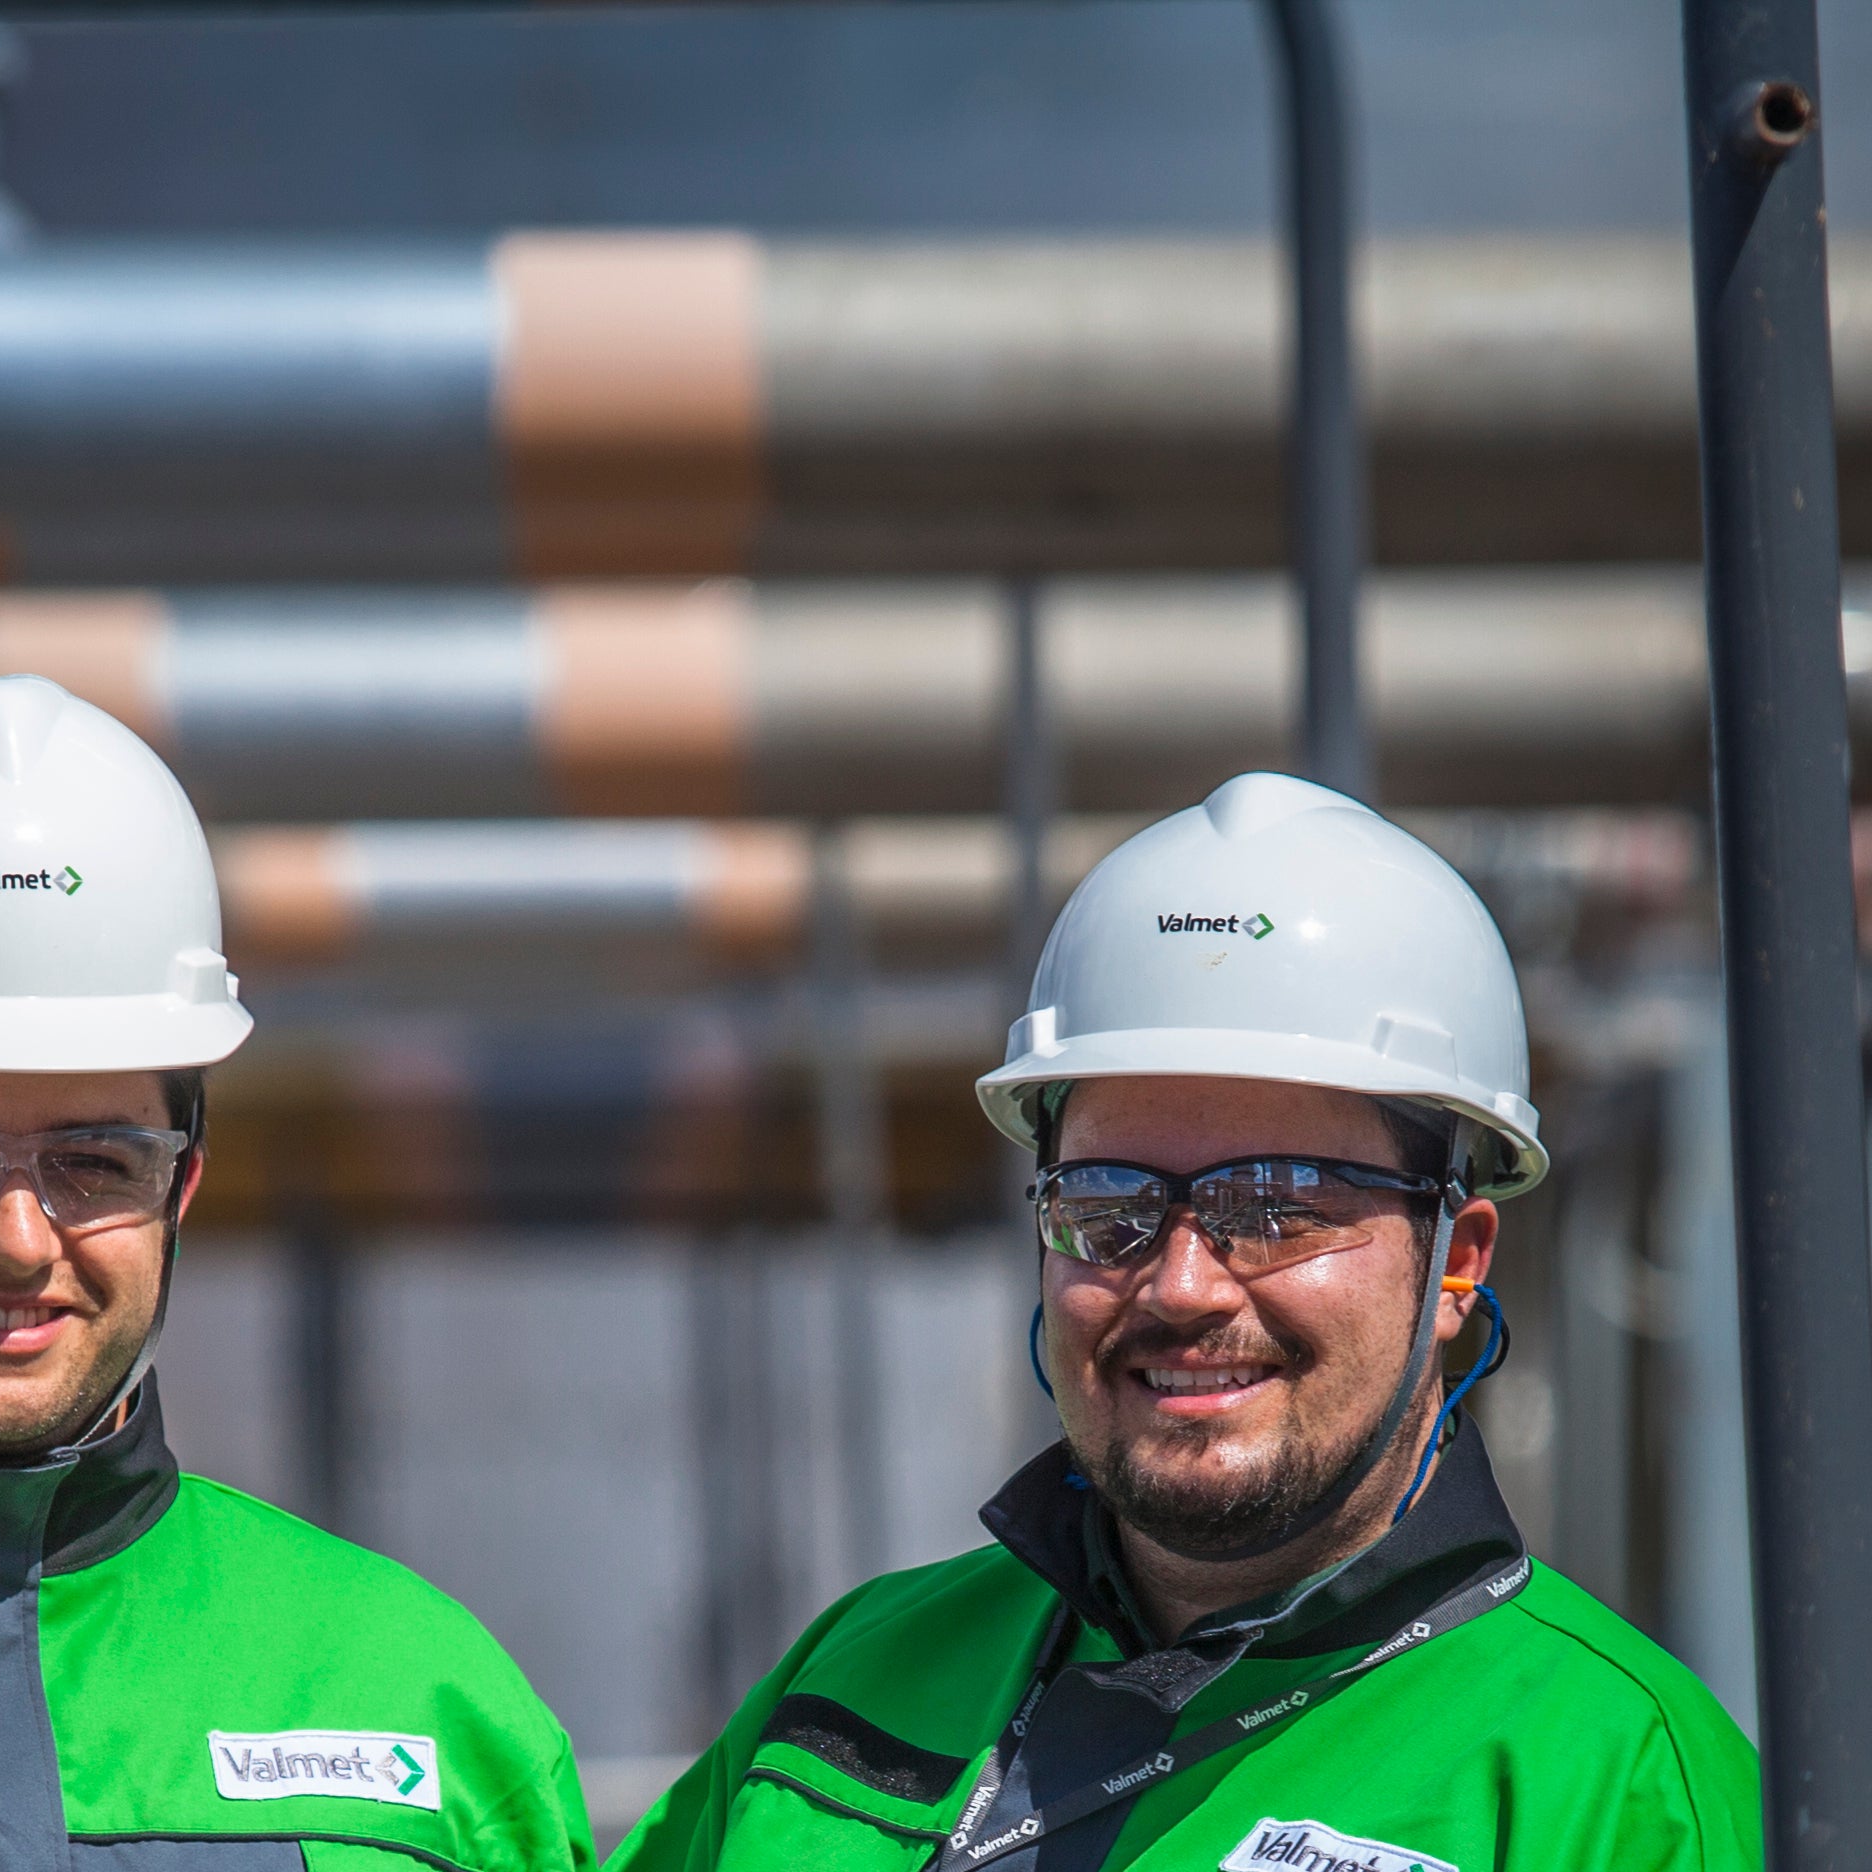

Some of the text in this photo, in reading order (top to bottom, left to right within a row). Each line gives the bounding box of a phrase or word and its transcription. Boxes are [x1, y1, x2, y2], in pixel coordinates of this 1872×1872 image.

[1157, 913, 1240, 933] Valmet
[1485, 1565, 1526, 1598] Valmet
[1236, 1698, 1292, 1730] Valmet
[218, 1746, 375, 1783] Valmet
[1101, 1761, 1157, 1795] Valmet
[958, 1785, 996, 1831] Valmet
[967, 1828, 1022, 1860] Valmet
